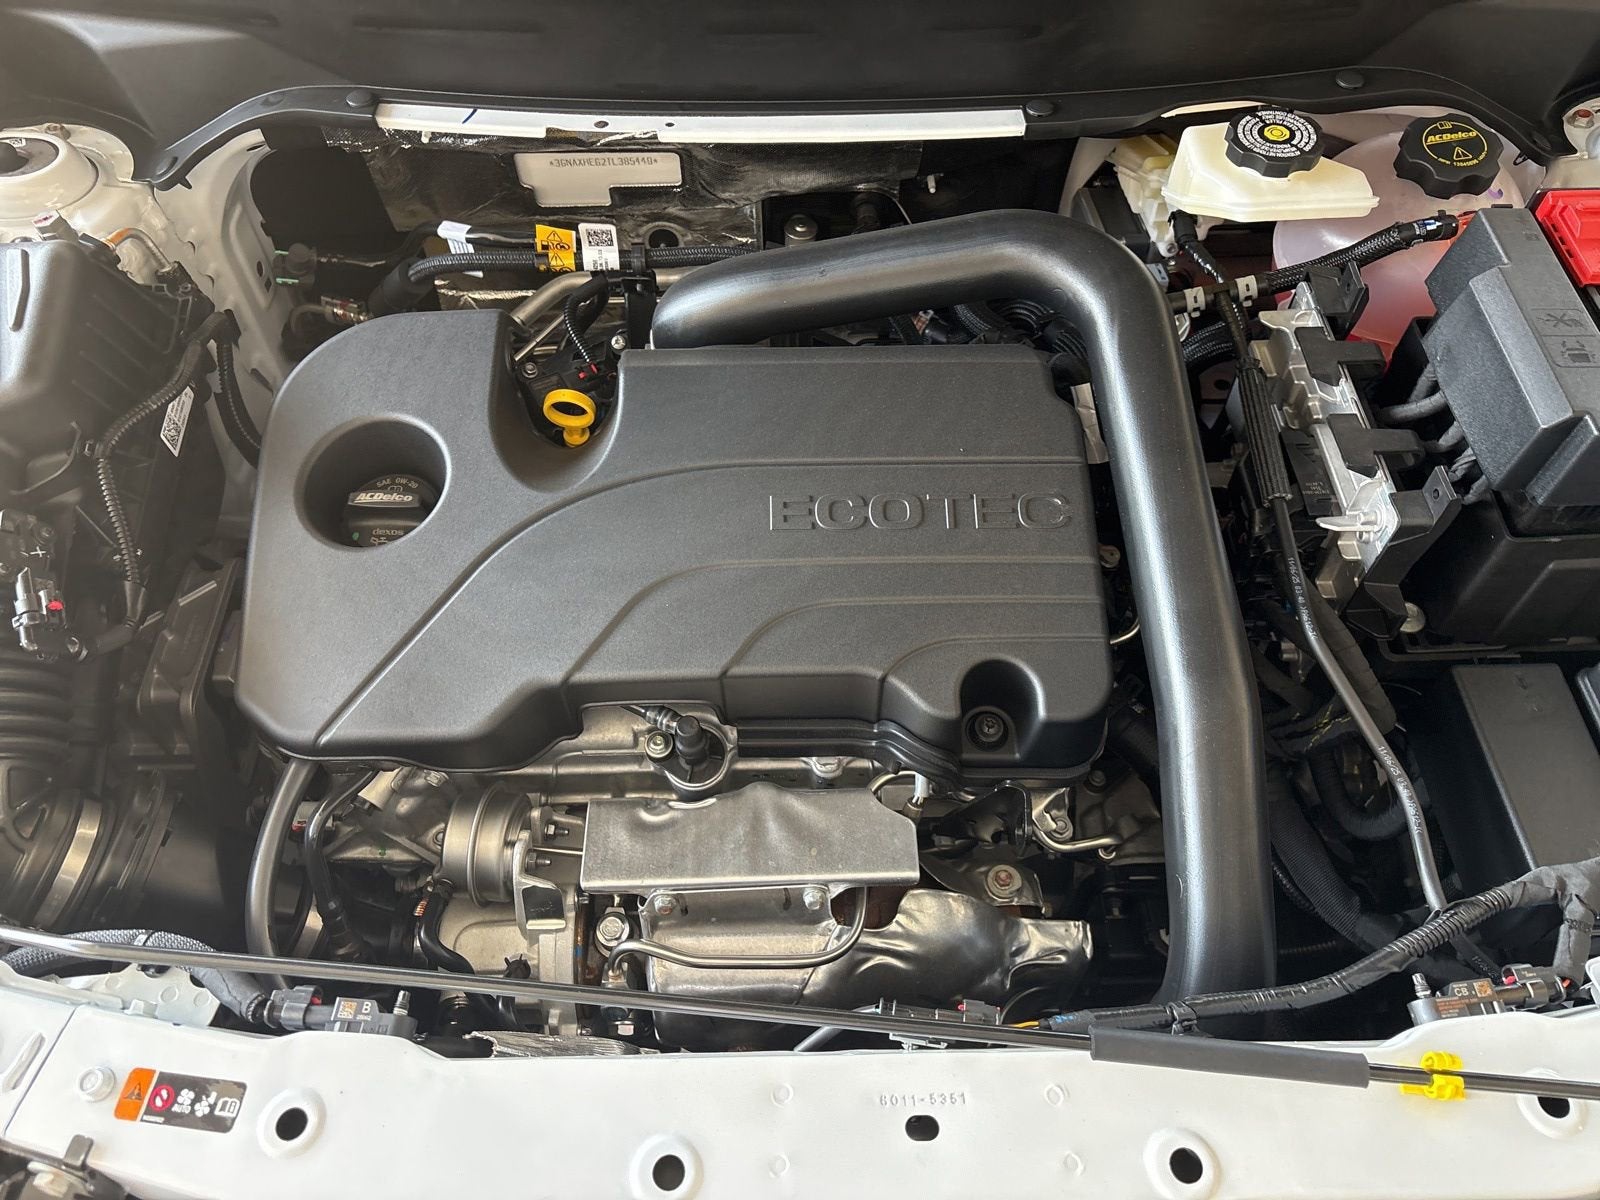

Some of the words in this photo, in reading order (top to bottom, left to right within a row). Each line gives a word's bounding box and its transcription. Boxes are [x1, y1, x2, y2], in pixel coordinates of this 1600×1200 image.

[1427, 131, 1477, 142] ACDelco
[376, 478, 392, 488] SAE
[395, 477, 419, 489] 0W-20
[354, 492, 413, 502] ACDelco
[769, 493, 1073, 530] ECOTEC
[372, 528, 405, 536] dexos
[1454, 987, 1469, 997] CB
[361, 1001, 372, 1013] B
[880, 1092, 966, 1106] 6011-5351
[171, 1103, 191, 1114] AUTO
